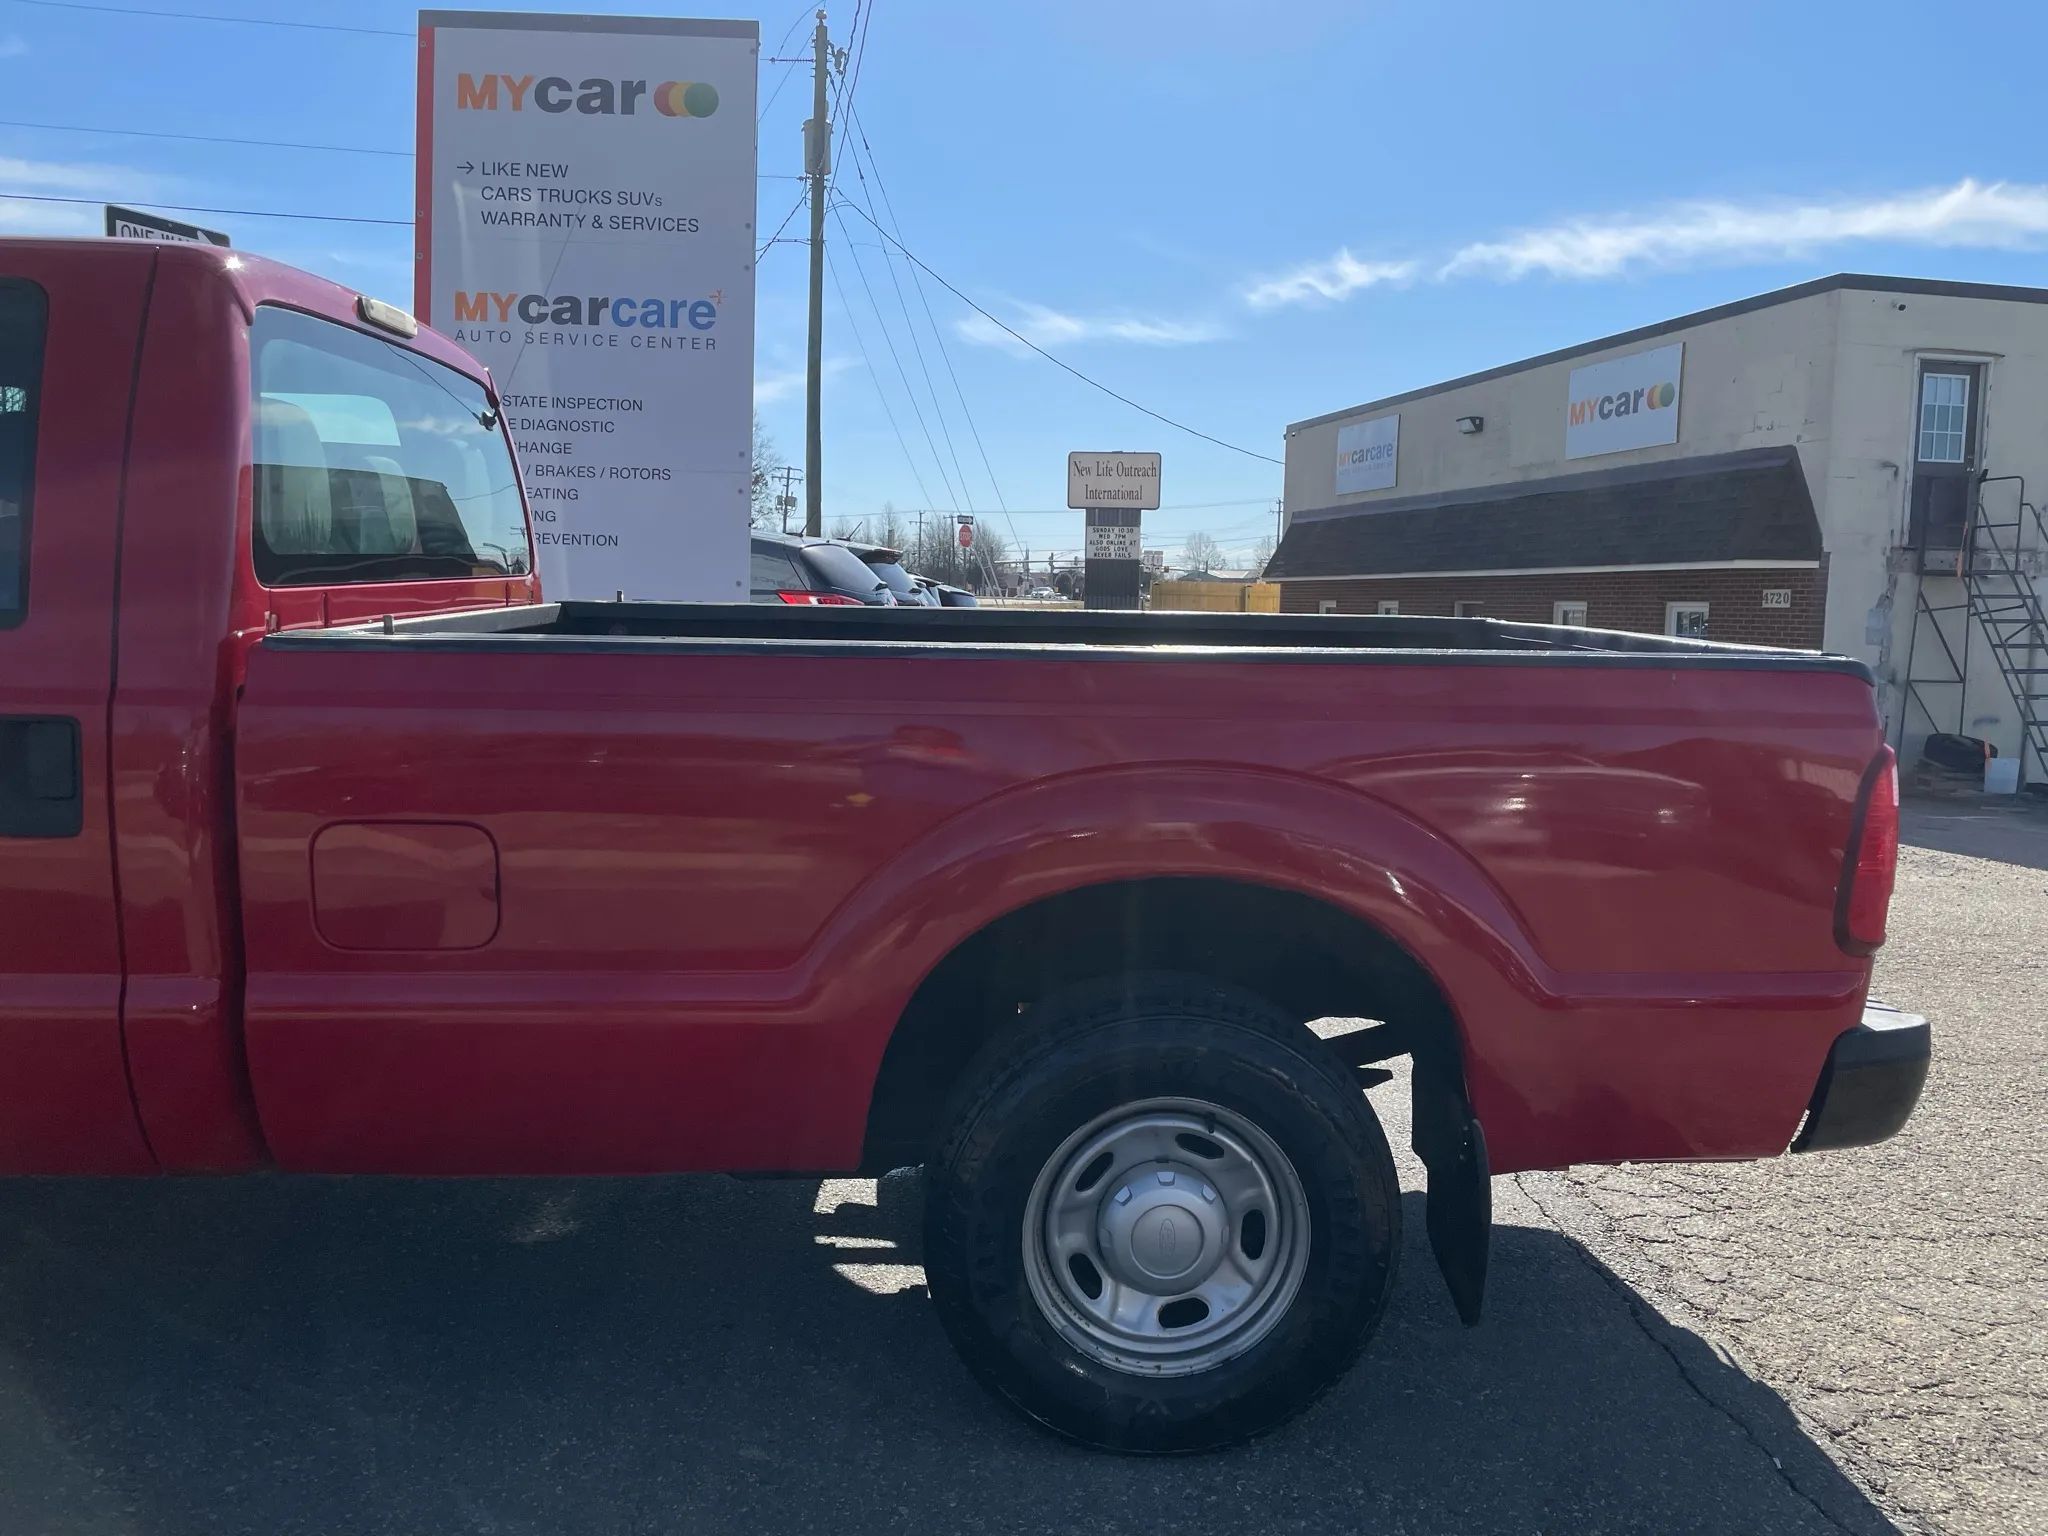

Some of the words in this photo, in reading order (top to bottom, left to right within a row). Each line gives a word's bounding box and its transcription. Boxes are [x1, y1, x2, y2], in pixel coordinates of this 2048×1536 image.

[457, 73, 647, 116] MYcar
[481, 162, 521, 177] LIKE
[526, 163, 569, 179] NEW
[481, 186, 532, 202] CARS
[537, 188, 612, 206] TRUCKS
[617, 191, 663, 208] SUVs
[481, 211, 586, 229] WARRANTY
[591, 214, 604, 230] &
[609, 216, 699, 233] SERVICES
[454, 290, 717, 331] MYcarcare
[455, 329, 512, 345] AUTO
[524, 331, 619, 347] SERVICE
[631, 335, 717, 350] CENTER
[502, 394, 547, 409] STATE
[551, 397, 643, 411] INSPECTION
[1569, 387, 1645, 427] MYcar
[521, 418, 615, 433] DIAGNOSTIC
[535, 464, 596, 478] BRAKES
[609, 466, 671, 481] ROTORS
[1073, 460, 1092, 477] New
[1096, 460, 1113, 477] Life
[1116, 460, 1157, 478] Outreach
[526, 487, 579, 501] EATING
[1085, 484, 1143, 501] International
